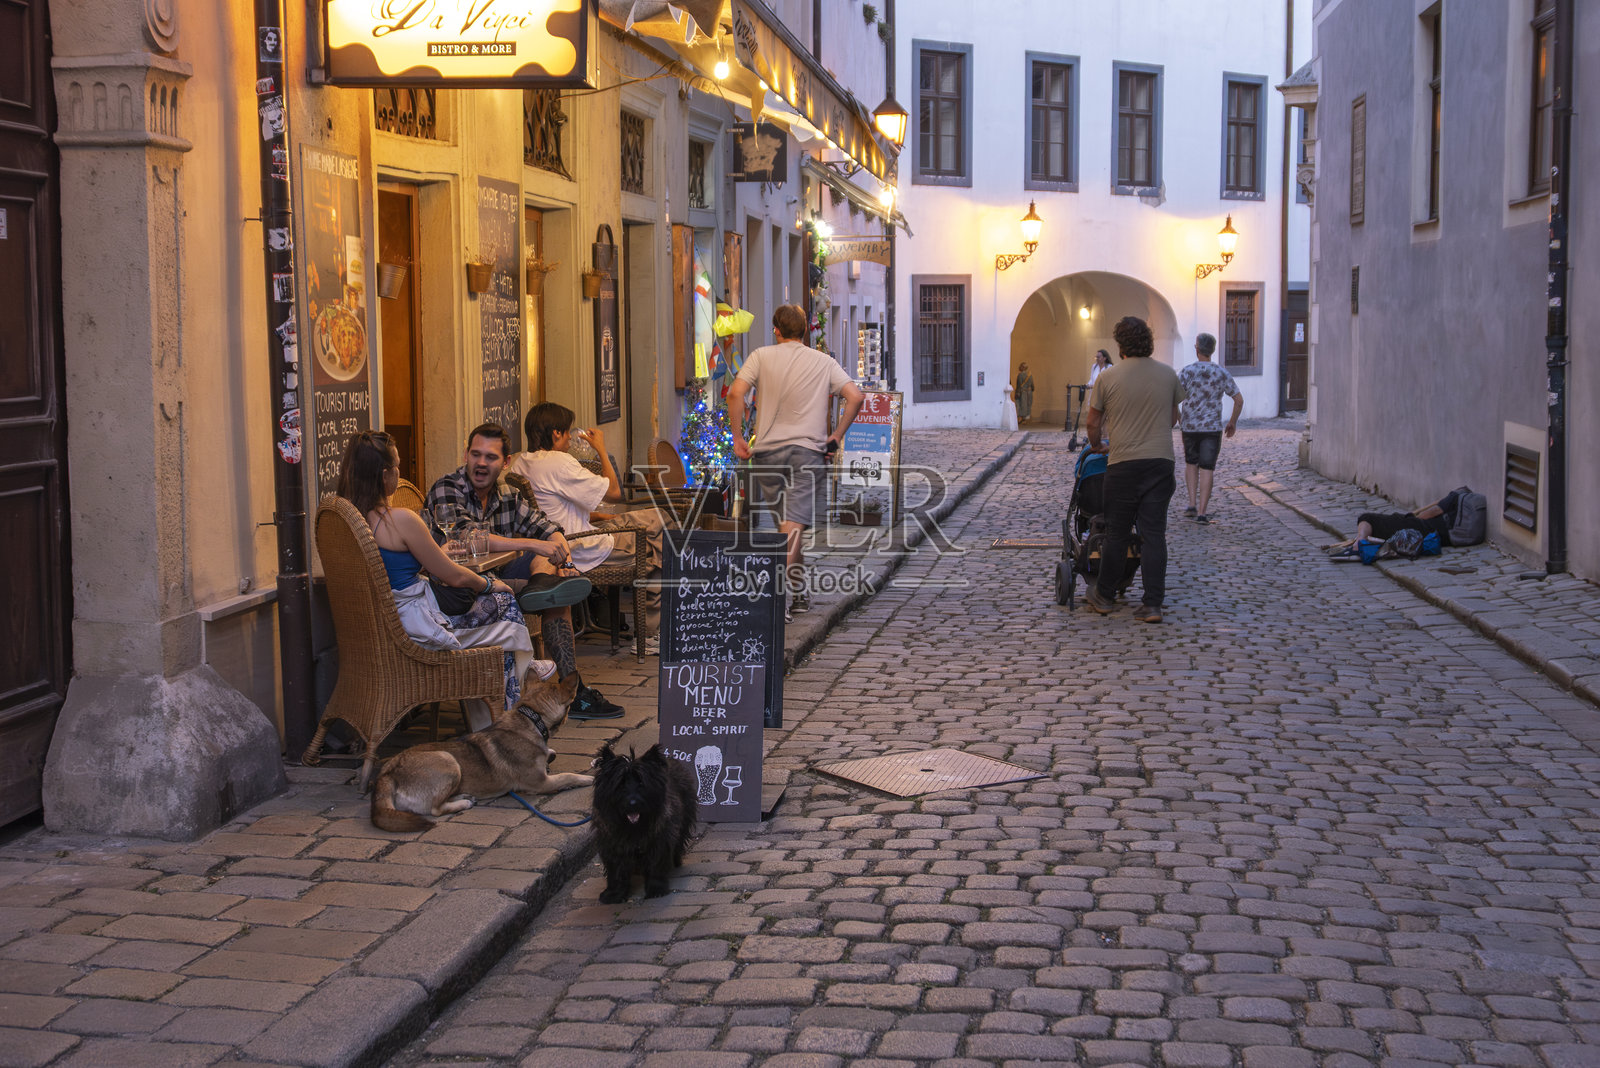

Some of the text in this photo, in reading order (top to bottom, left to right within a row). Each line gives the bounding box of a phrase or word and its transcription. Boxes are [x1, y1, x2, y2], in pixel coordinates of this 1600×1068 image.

[431, 44, 512, 54] BISTRO & MORE
[315, 391, 347, 414] TOURIST
[860, 398, 880, 413] 1€
[317, 417, 358, 438] LOCAL BEER
[319, 441, 340, 459] LOCAL
[854, 461, 878, 470] DROP
[678, 577, 692, 598] &
[663, 664, 764, 688] TOURIST
[685, 686, 742, 706] MENU
[693, 707, 726, 718] BEER
[672, 725, 749, 736] LOCAL SPIRIT
